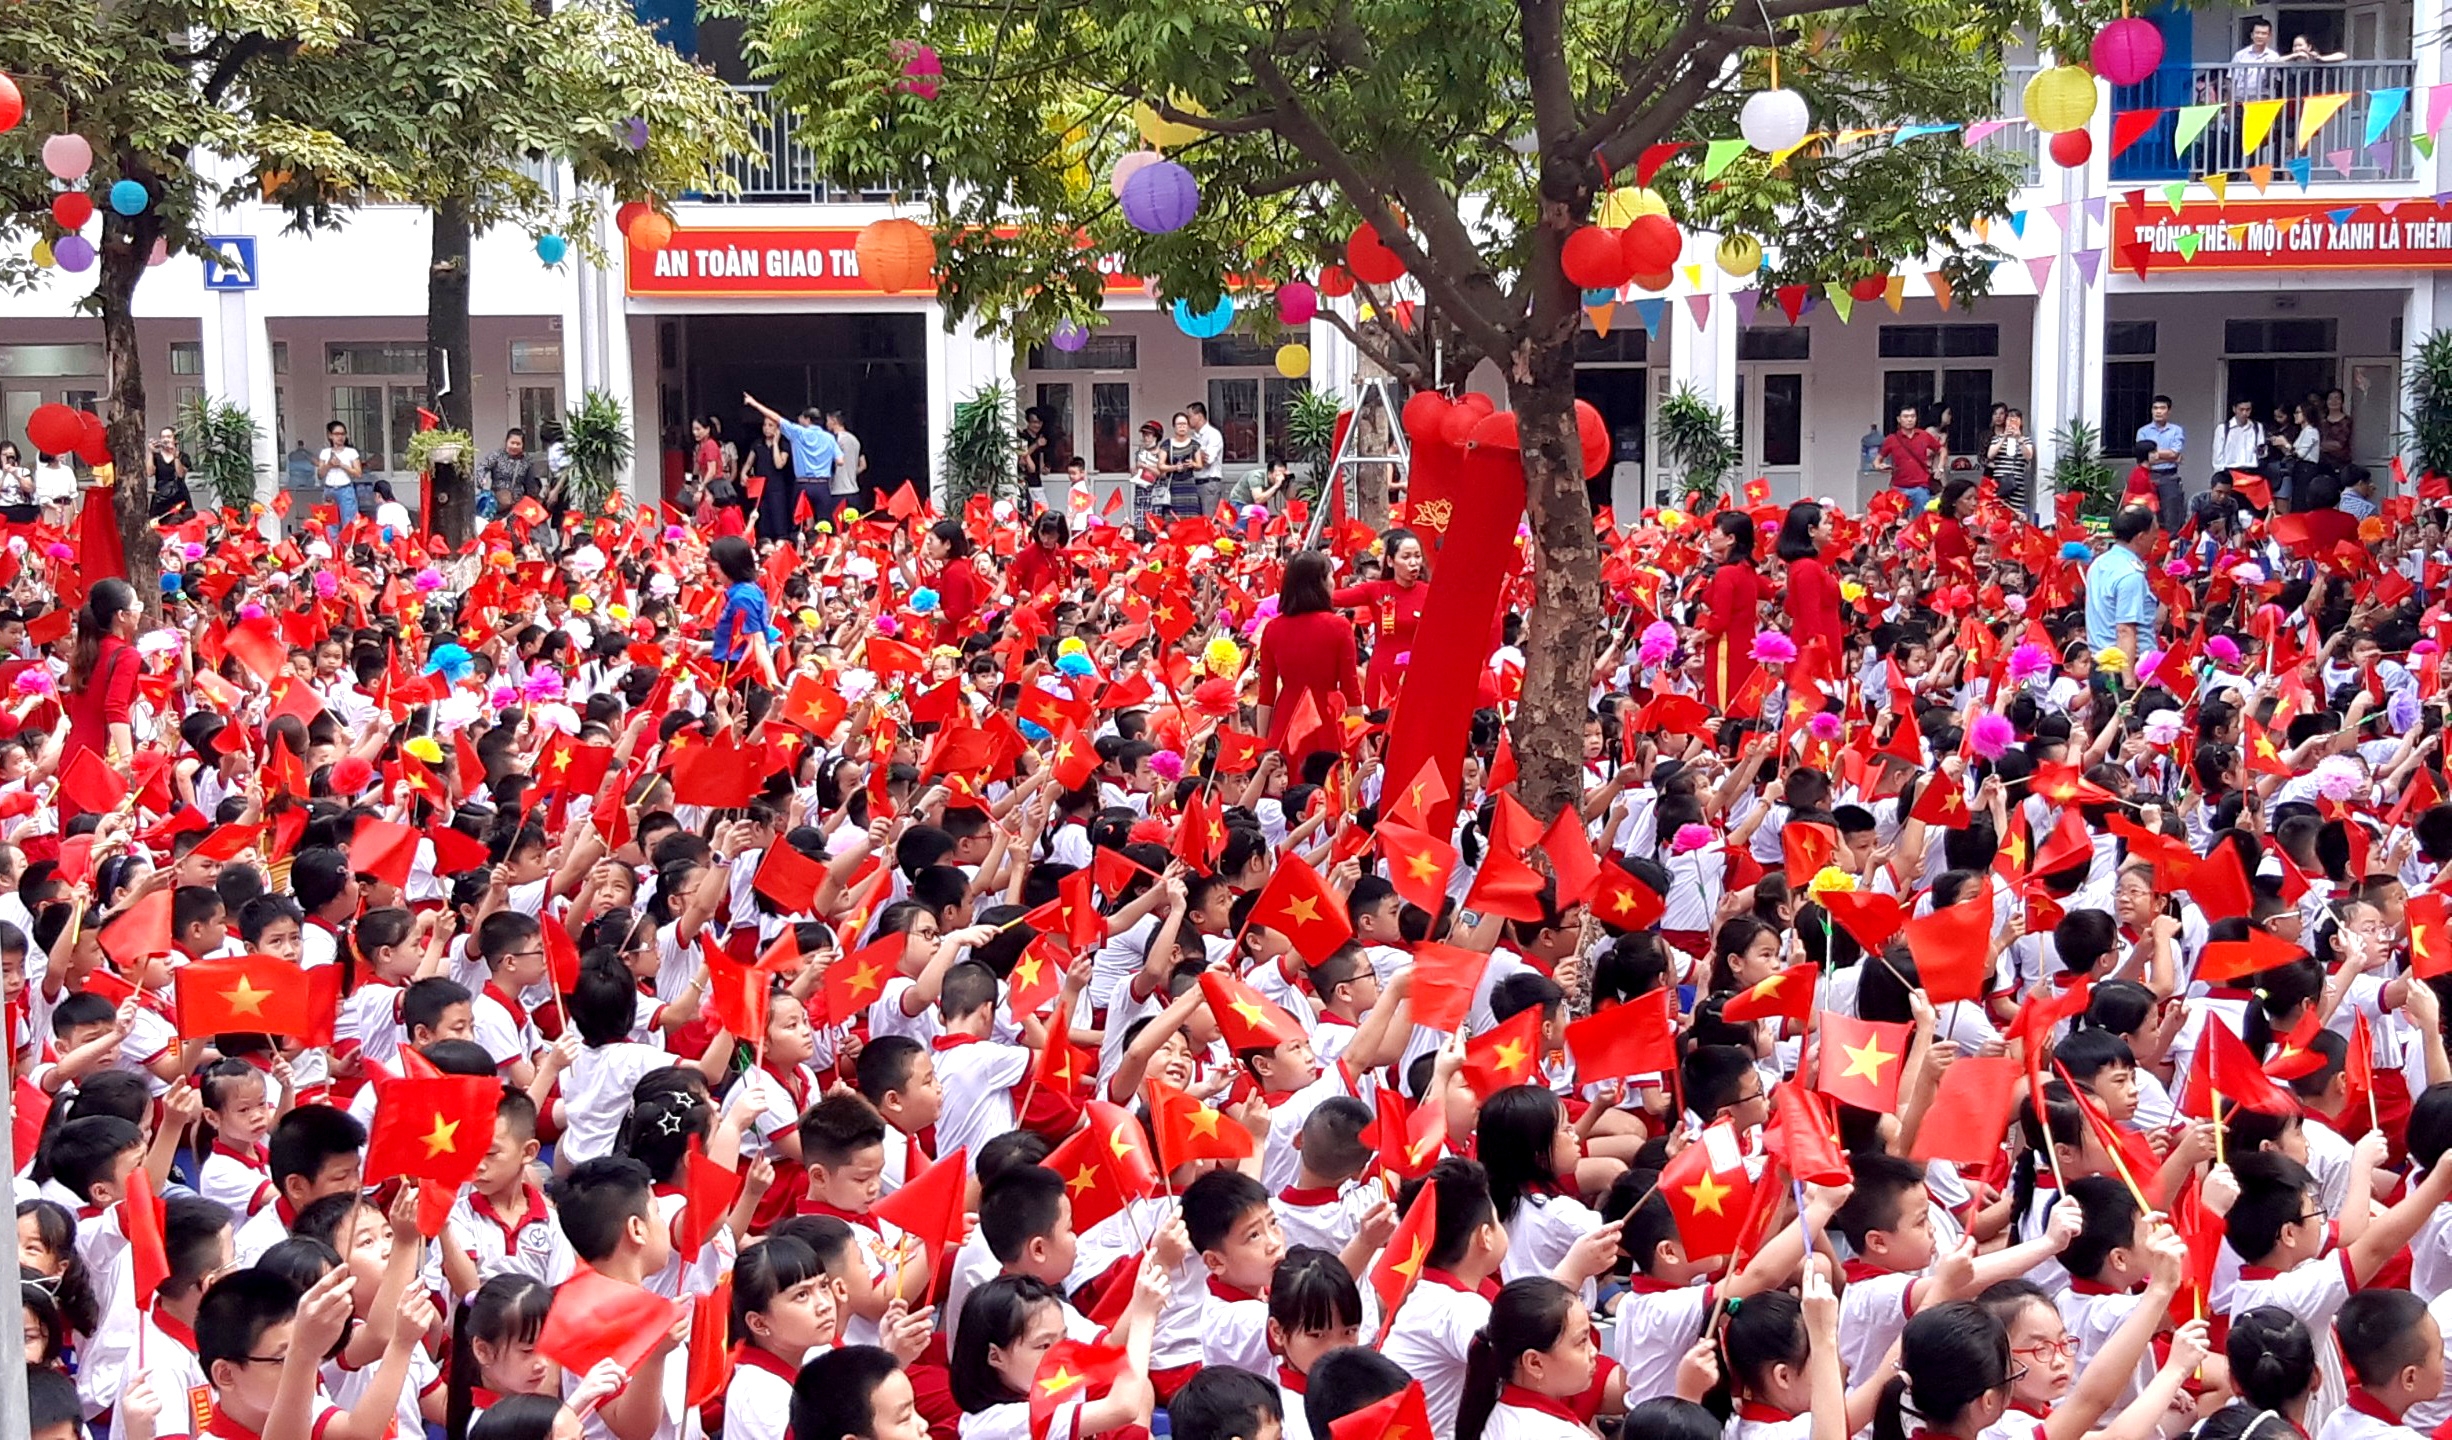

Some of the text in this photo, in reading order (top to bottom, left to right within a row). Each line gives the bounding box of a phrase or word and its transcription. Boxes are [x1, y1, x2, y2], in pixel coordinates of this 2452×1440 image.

[2248, 218, 2283, 257] MỘT
[2289, 217, 2323, 251] CÂY
[2327, 223, 2374, 250] XANH
[2379, 217, 2400, 249] LÀ
[2405, 217, 2452, 249] THÊM
[212, 243, 251, 282] A
[654, 249, 689, 277] AN
[695, 244, 759, 277] TOÀN
[766, 249, 823, 277] GIAO
